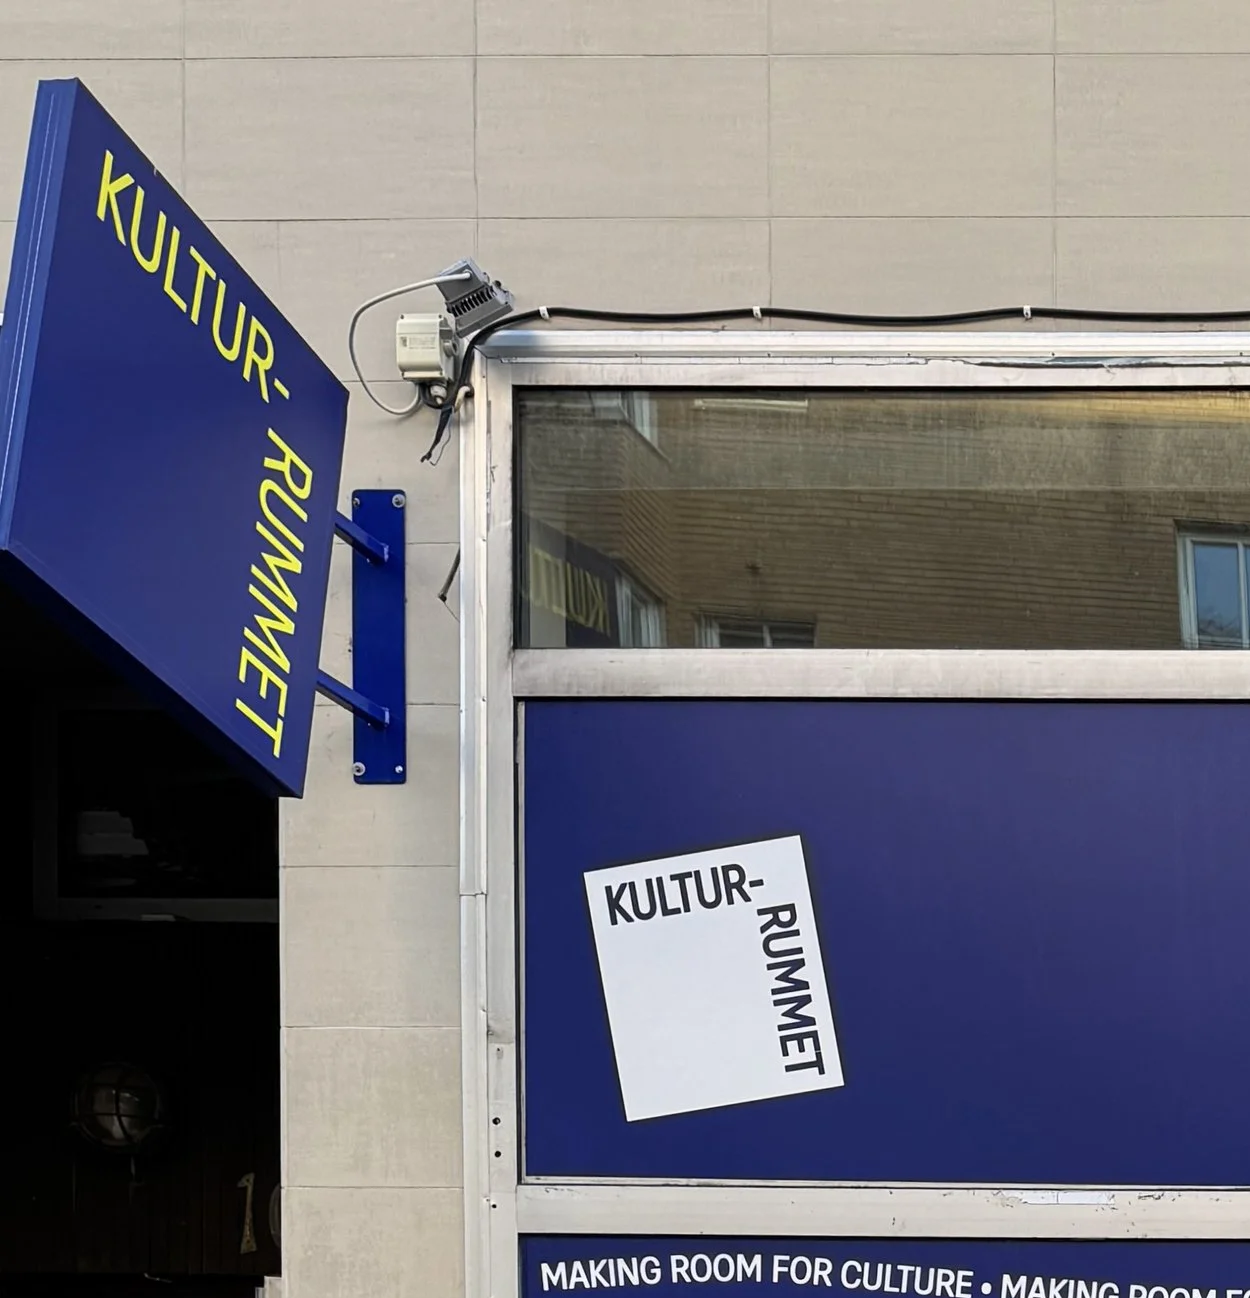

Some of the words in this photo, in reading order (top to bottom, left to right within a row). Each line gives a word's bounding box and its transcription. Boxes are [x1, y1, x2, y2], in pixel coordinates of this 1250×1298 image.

[97, 150, 290, 402] KULTUR-
[236, 427, 312, 758] RUMMET
[605, 863, 765, 925] KULTUR-
[756, 903, 826, 1075] RUMMET
[540, 1255, 662, 1290] MAKING
[670, 1253, 762, 1283] ROOM
[772, 1254, 833, 1287] FOR
[840, 1260, 974, 1298] CULTURE
